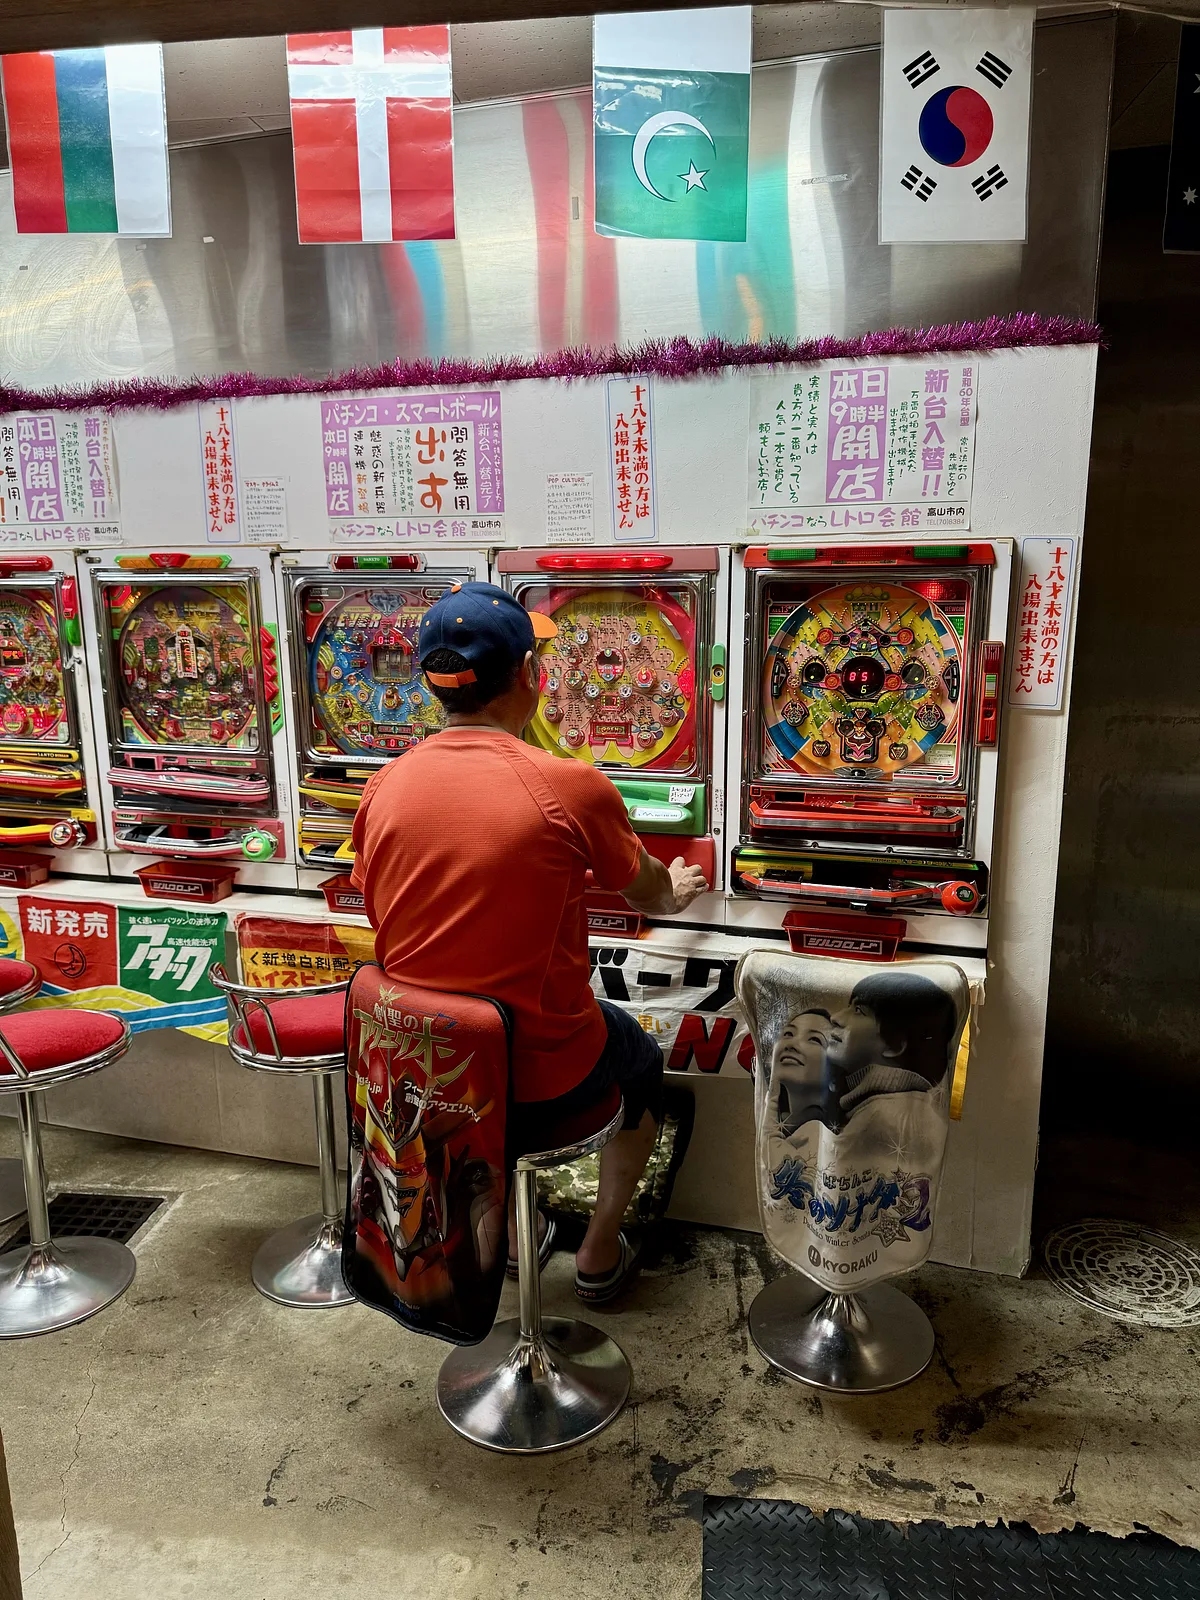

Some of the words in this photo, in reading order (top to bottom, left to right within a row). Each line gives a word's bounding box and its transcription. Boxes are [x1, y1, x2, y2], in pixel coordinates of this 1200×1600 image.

[806, 375, 821, 455] 実績と実力は
[830, 401, 885, 425] 9時半
[831, 370, 886, 399] 本日
[959, 367, 973, 427] 昭和60年台型
[18, 418, 55, 441] 本日
[20, 442, 57, 461] 9時半
[324, 430, 348, 444] 本日
[324, 446, 348, 458] 9時半
[630, 385, 651, 518] 十八才未満の方は
[774, 400, 786, 493] 人気一本を貫く
[789, 383, 803, 504] 貴方が一番知っている
[25, 461, 60, 520] 開店
[204, 431, 223, 533] 入場出来ません
[215, 407, 236, 524] 十八才未満の方は
[328, 461, 350, 512] 開店
[415, 426, 448, 515] 出す
[450, 426, 470, 511] 問答無用
[477, 423, 494, 509] 新台入替完了
[614, 413, 634, 529] 入場出来ません
[829, 425, 879, 500] 開店
[471, 520, 501, 529] 高山市内
[927, 507, 965, 517] 高山市内
[1014, 574, 1043, 694] 入場出来ません
[1037, 547, 1068, 685] 十八才未満の方は
[27, 906, 109, 939] 新発売
[123, 924, 213, 992] アタック
[822, 1250, 879, 1275] KYORAKU
[824, 1234, 851, 1247] Winter
